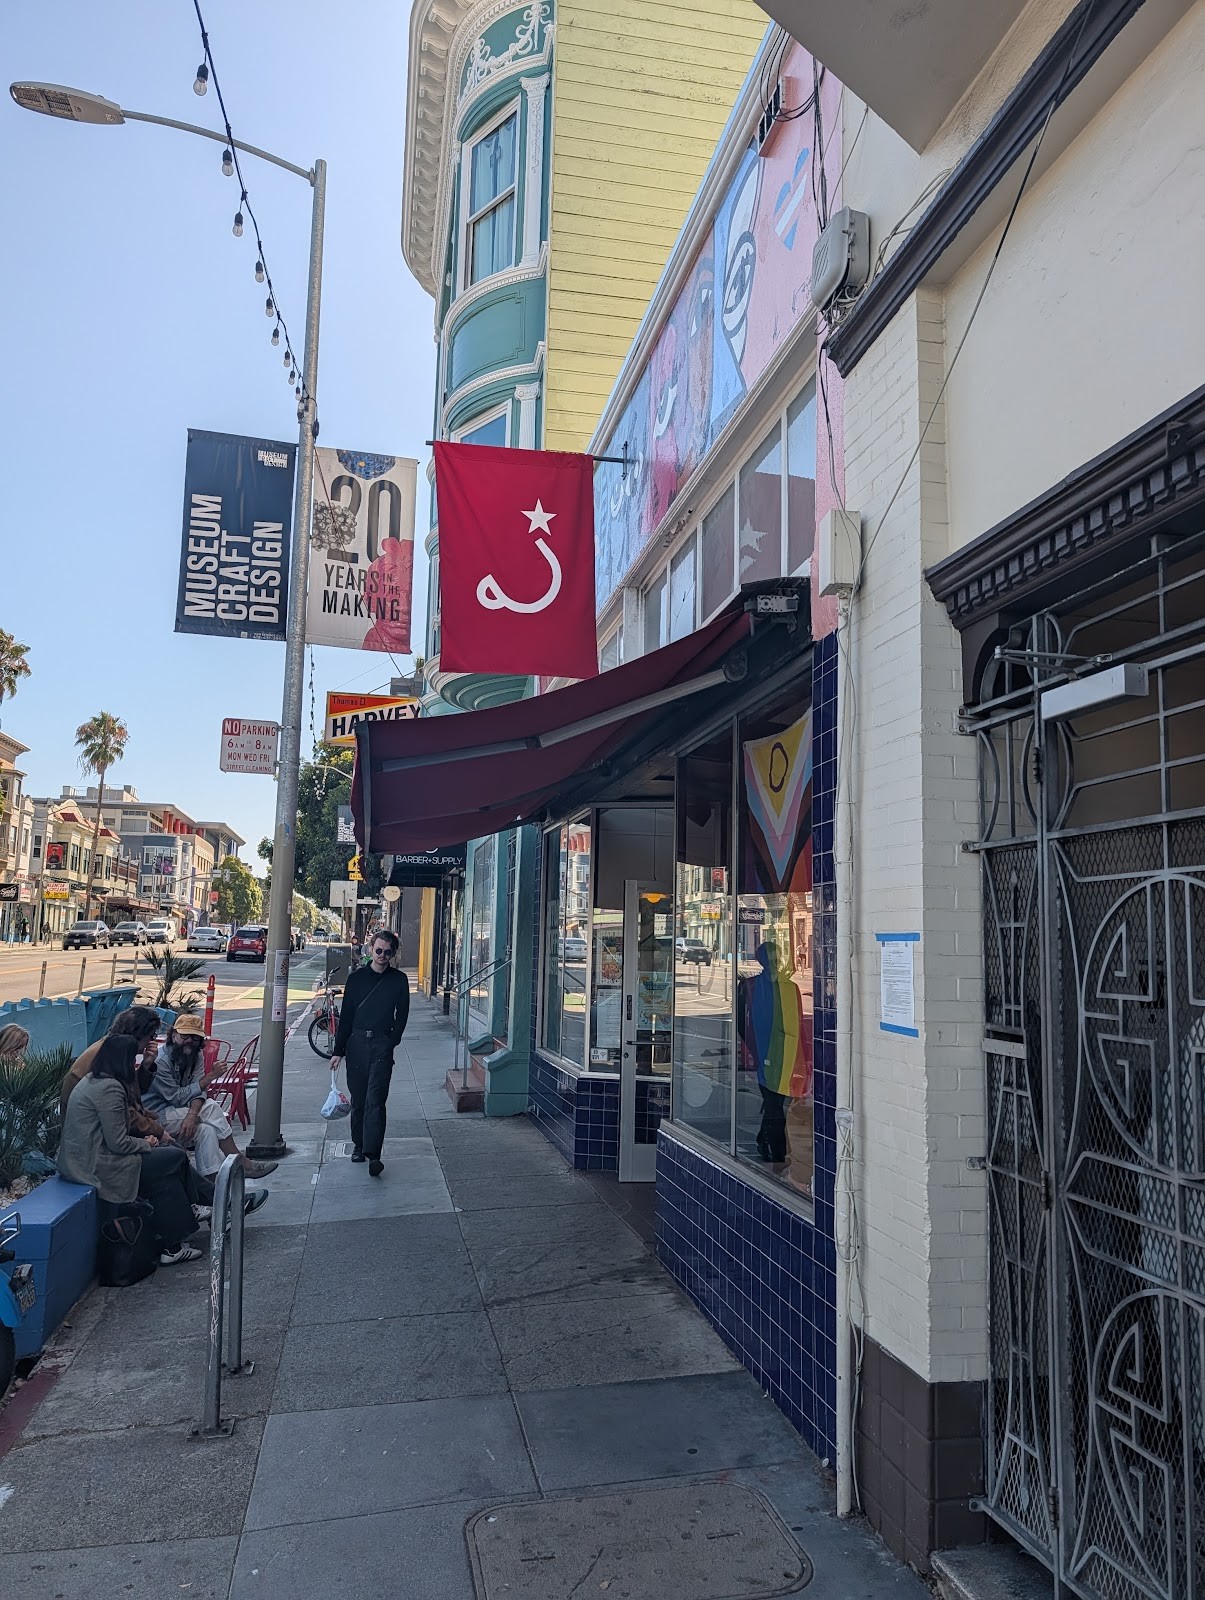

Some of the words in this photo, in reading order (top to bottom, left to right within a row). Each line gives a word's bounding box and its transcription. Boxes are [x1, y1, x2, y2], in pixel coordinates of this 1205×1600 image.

[326, 474, 401, 564] 20
[184, 493, 222, 618] MUSEUM
[216, 530, 251, 621] CRAFT
[249, 521, 283, 624] DESIGN
[324, 563, 380, 594] YEARS
[382, 573, 393, 582] IN
[322, 589, 400, 622] MAKING
[382, 584, 401, 596] THE
[224, 720, 240, 734] NO
[241, 725, 276, 737] PARKING
[227, 752, 241, 760] MON
[244, 753, 257, 762] WED
[260, 754, 270, 762] FRI
